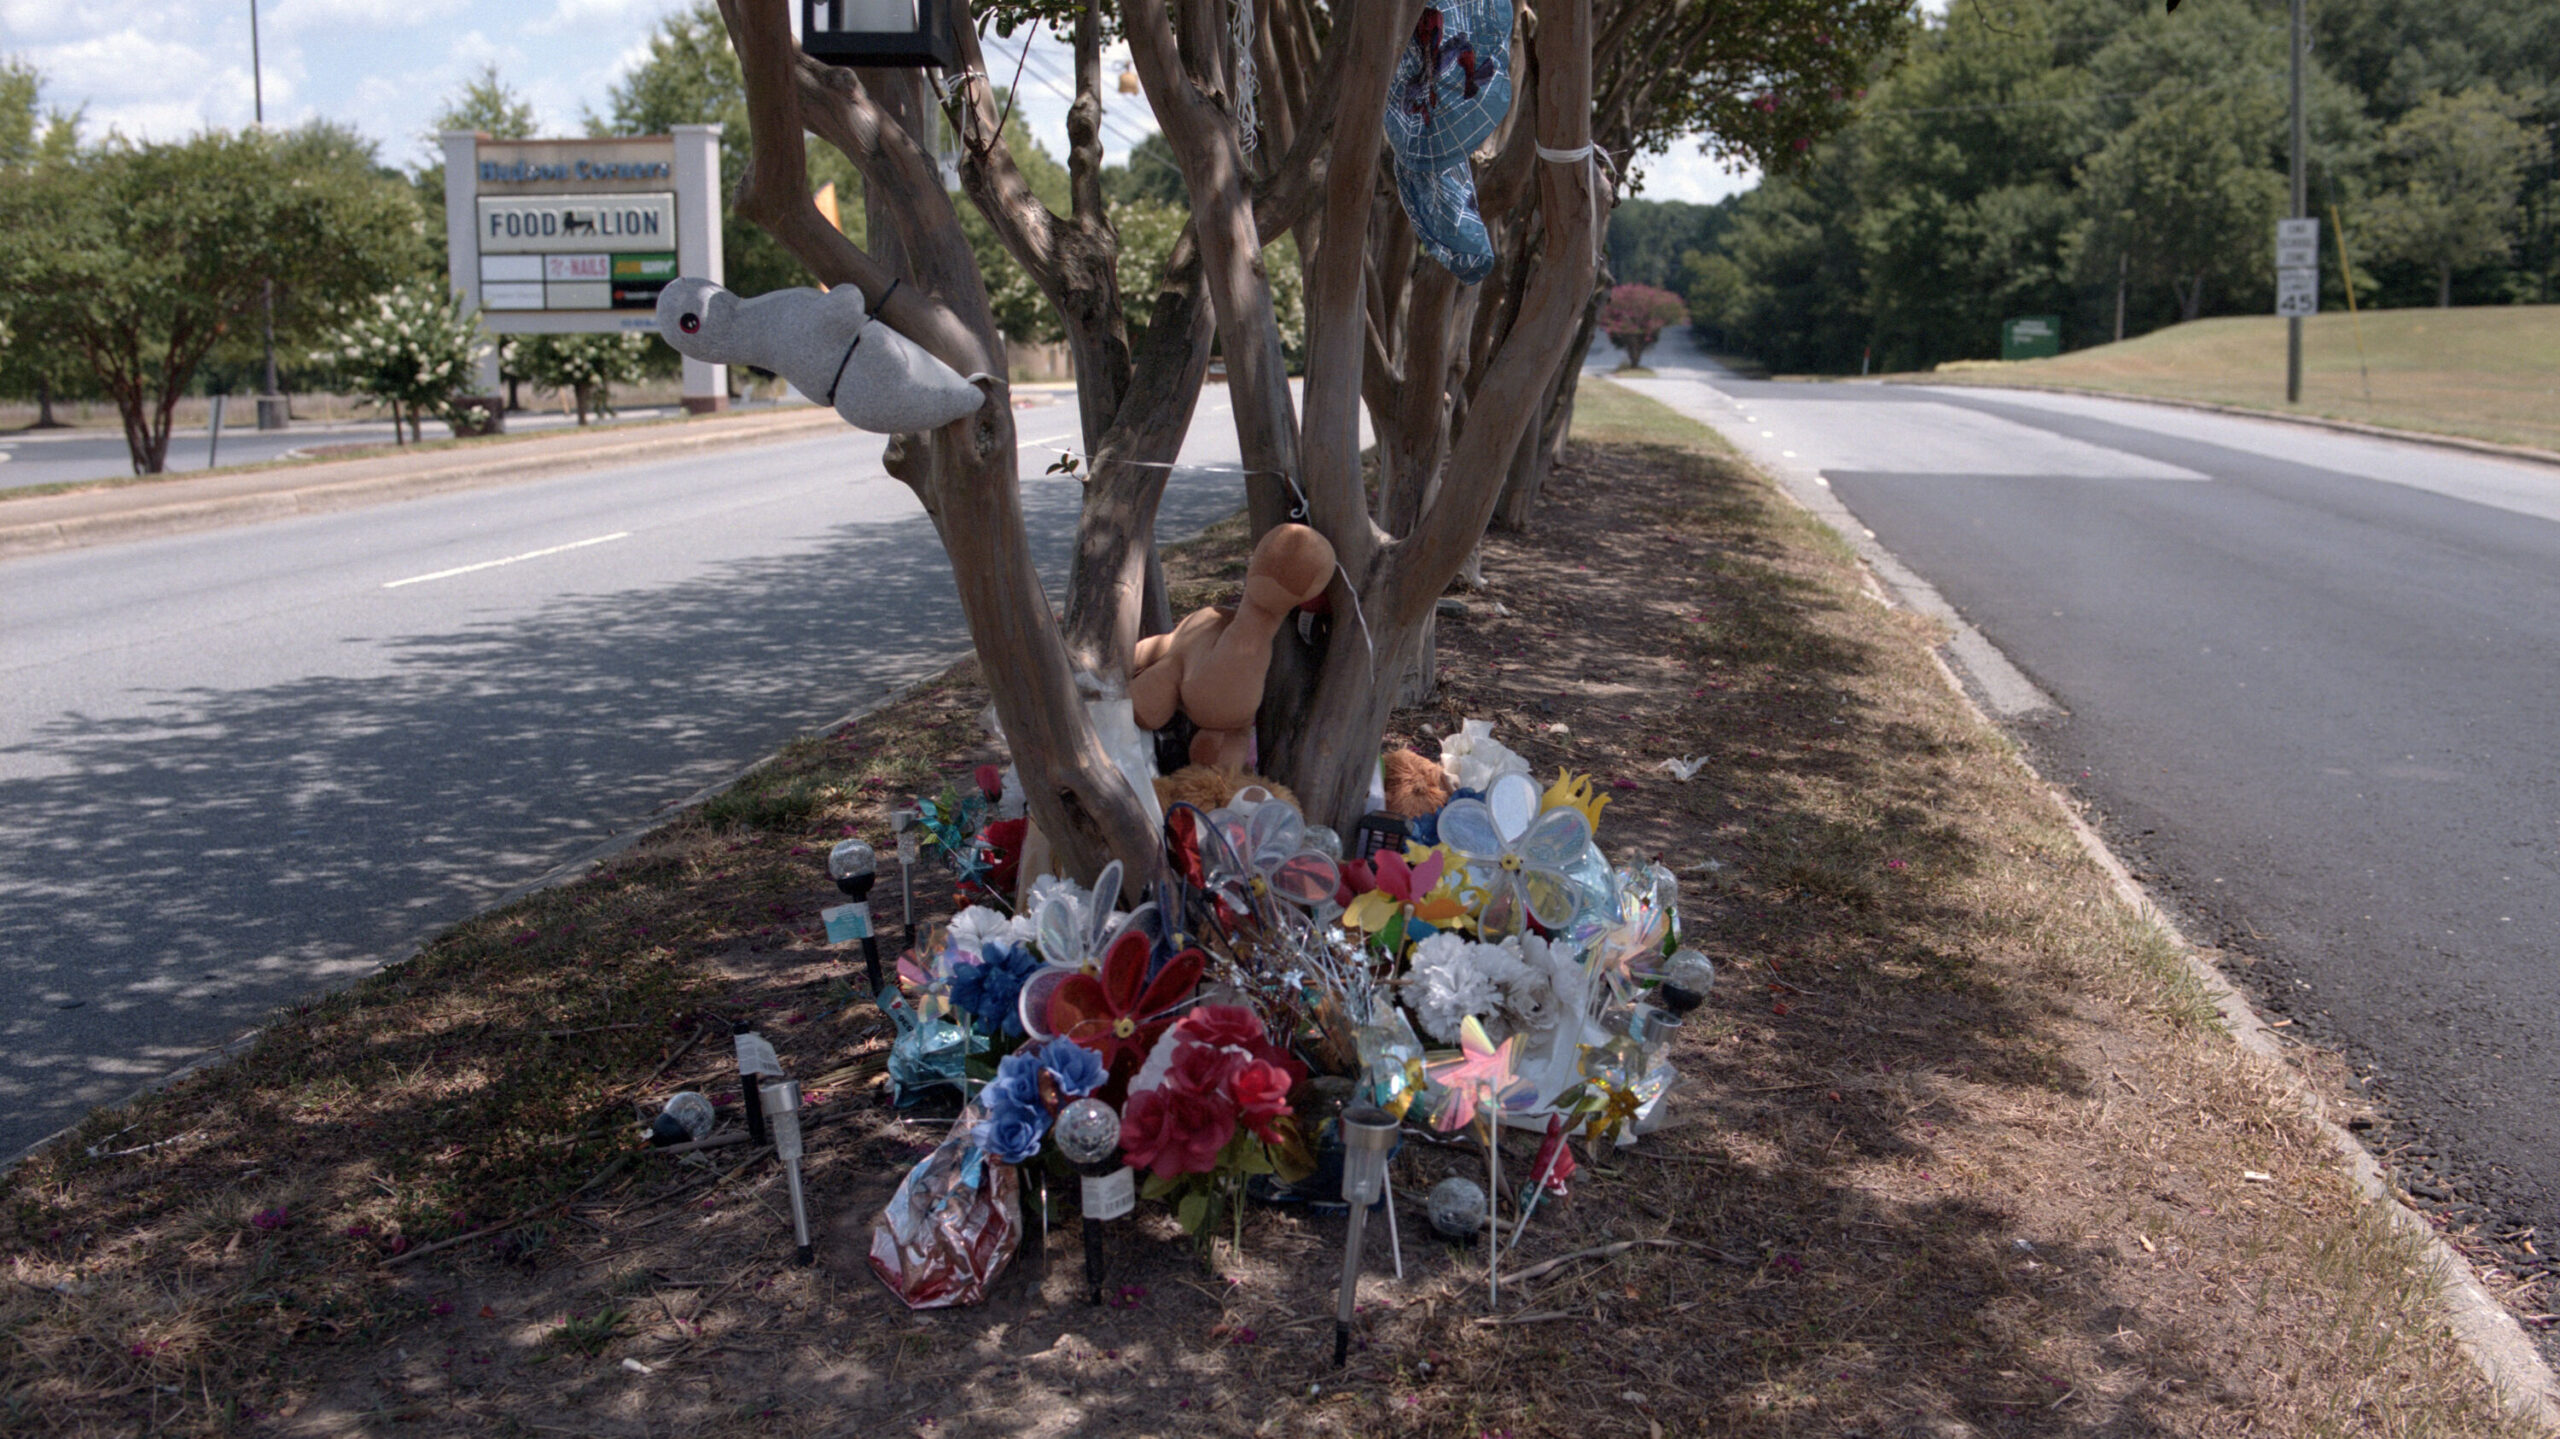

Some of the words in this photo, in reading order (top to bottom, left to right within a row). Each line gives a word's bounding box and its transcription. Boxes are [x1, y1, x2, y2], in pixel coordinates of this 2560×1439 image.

[479, 161, 569, 182] Hudson
[575, 160, 670, 180] Corners
[490, 212, 557, 236] FOOD
[600, 210, 658, 235] LION
[2280, 294, 2314, 312] 45
